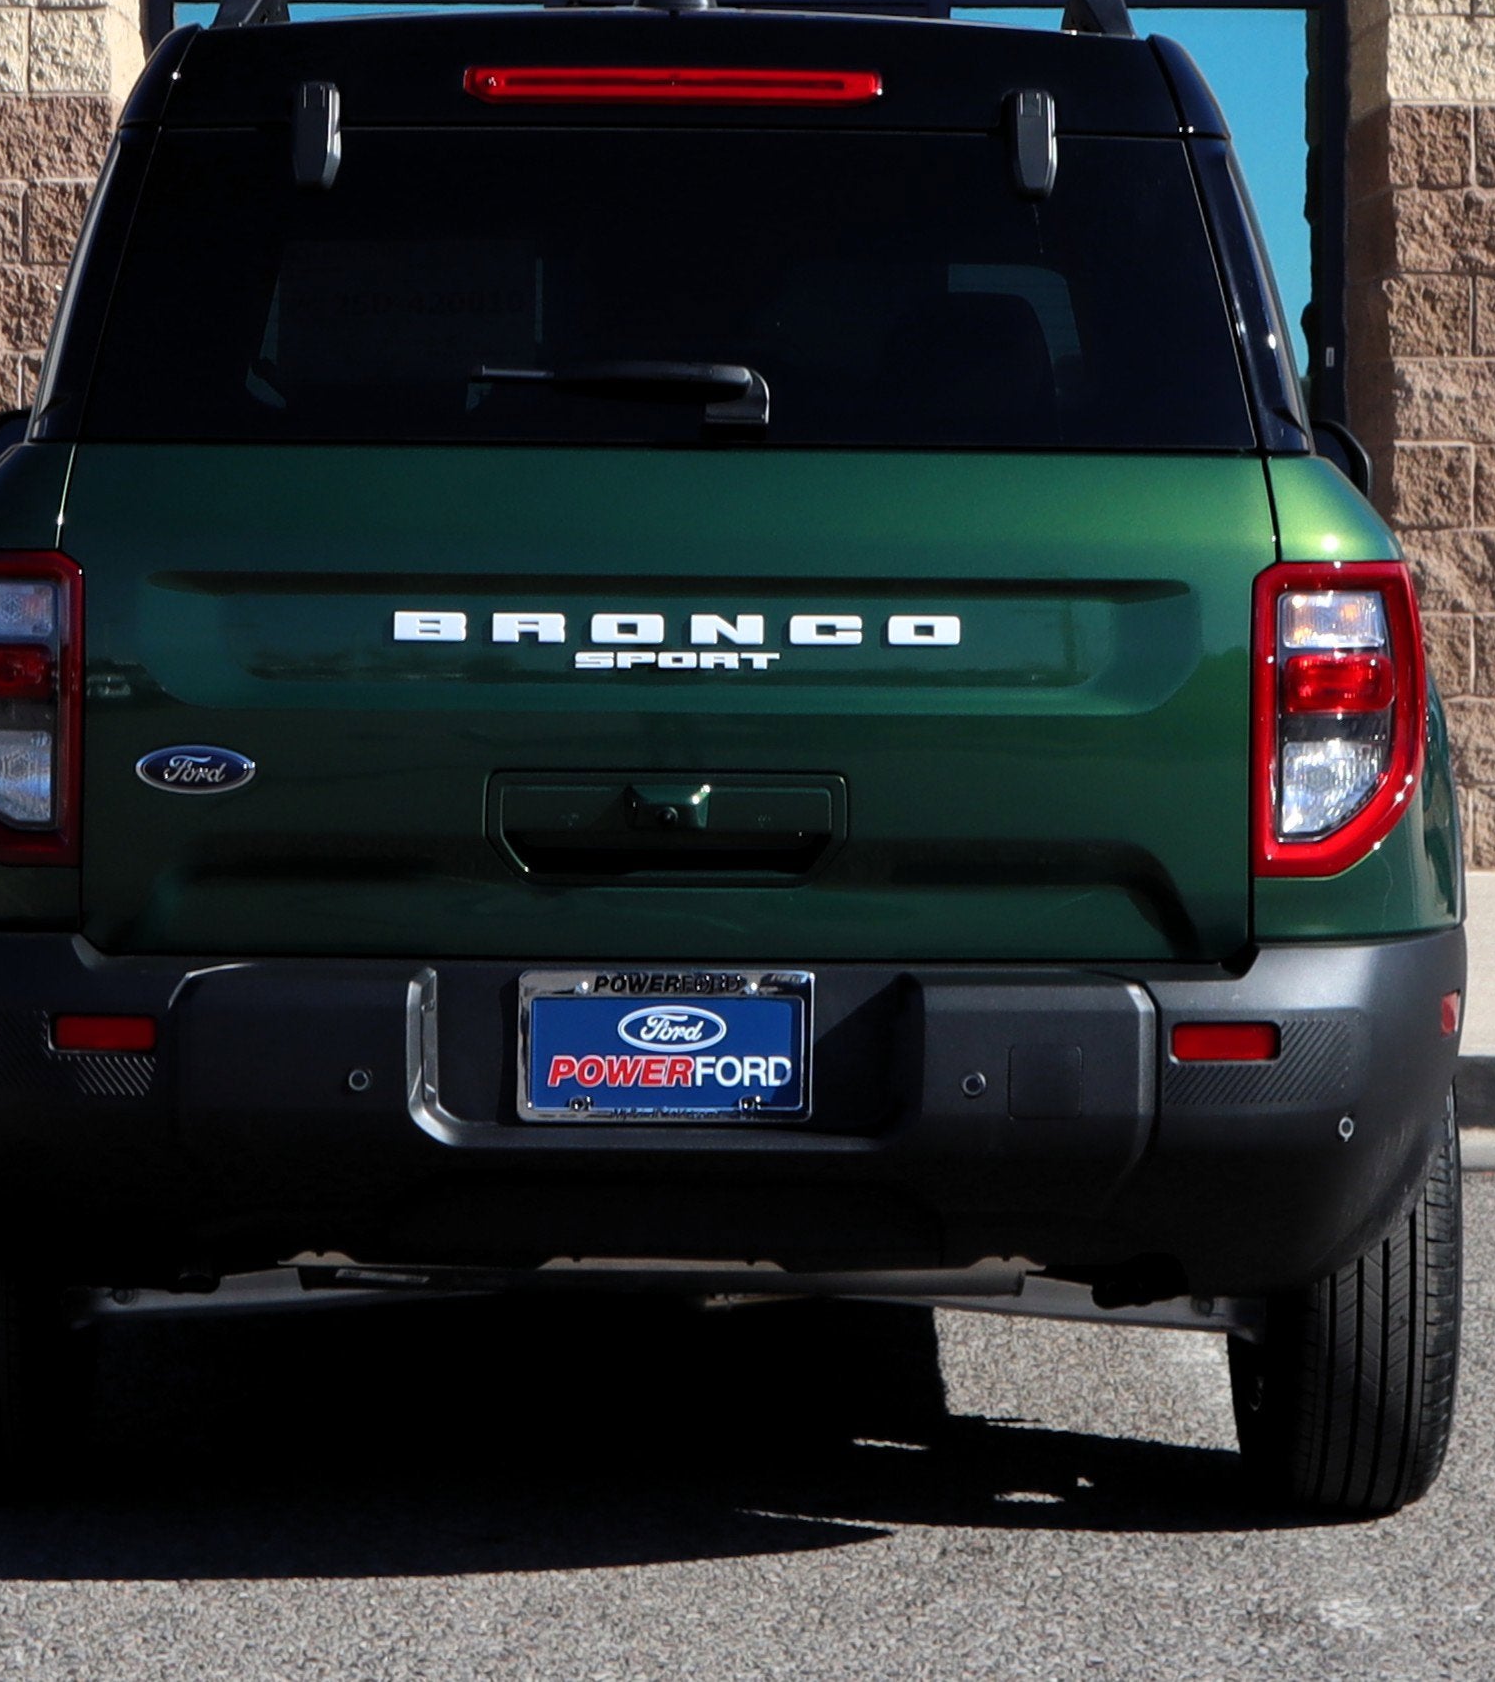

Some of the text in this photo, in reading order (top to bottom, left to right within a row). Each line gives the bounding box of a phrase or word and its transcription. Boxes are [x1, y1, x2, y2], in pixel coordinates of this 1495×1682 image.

[394, 611, 961, 646] BRONCO
[574, 651, 781, 670] SPORT
[163, 755, 227, 782] Ford
[640, 1013, 705, 1042] Ford
[547, 1054, 793, 1088] POWERFORD
